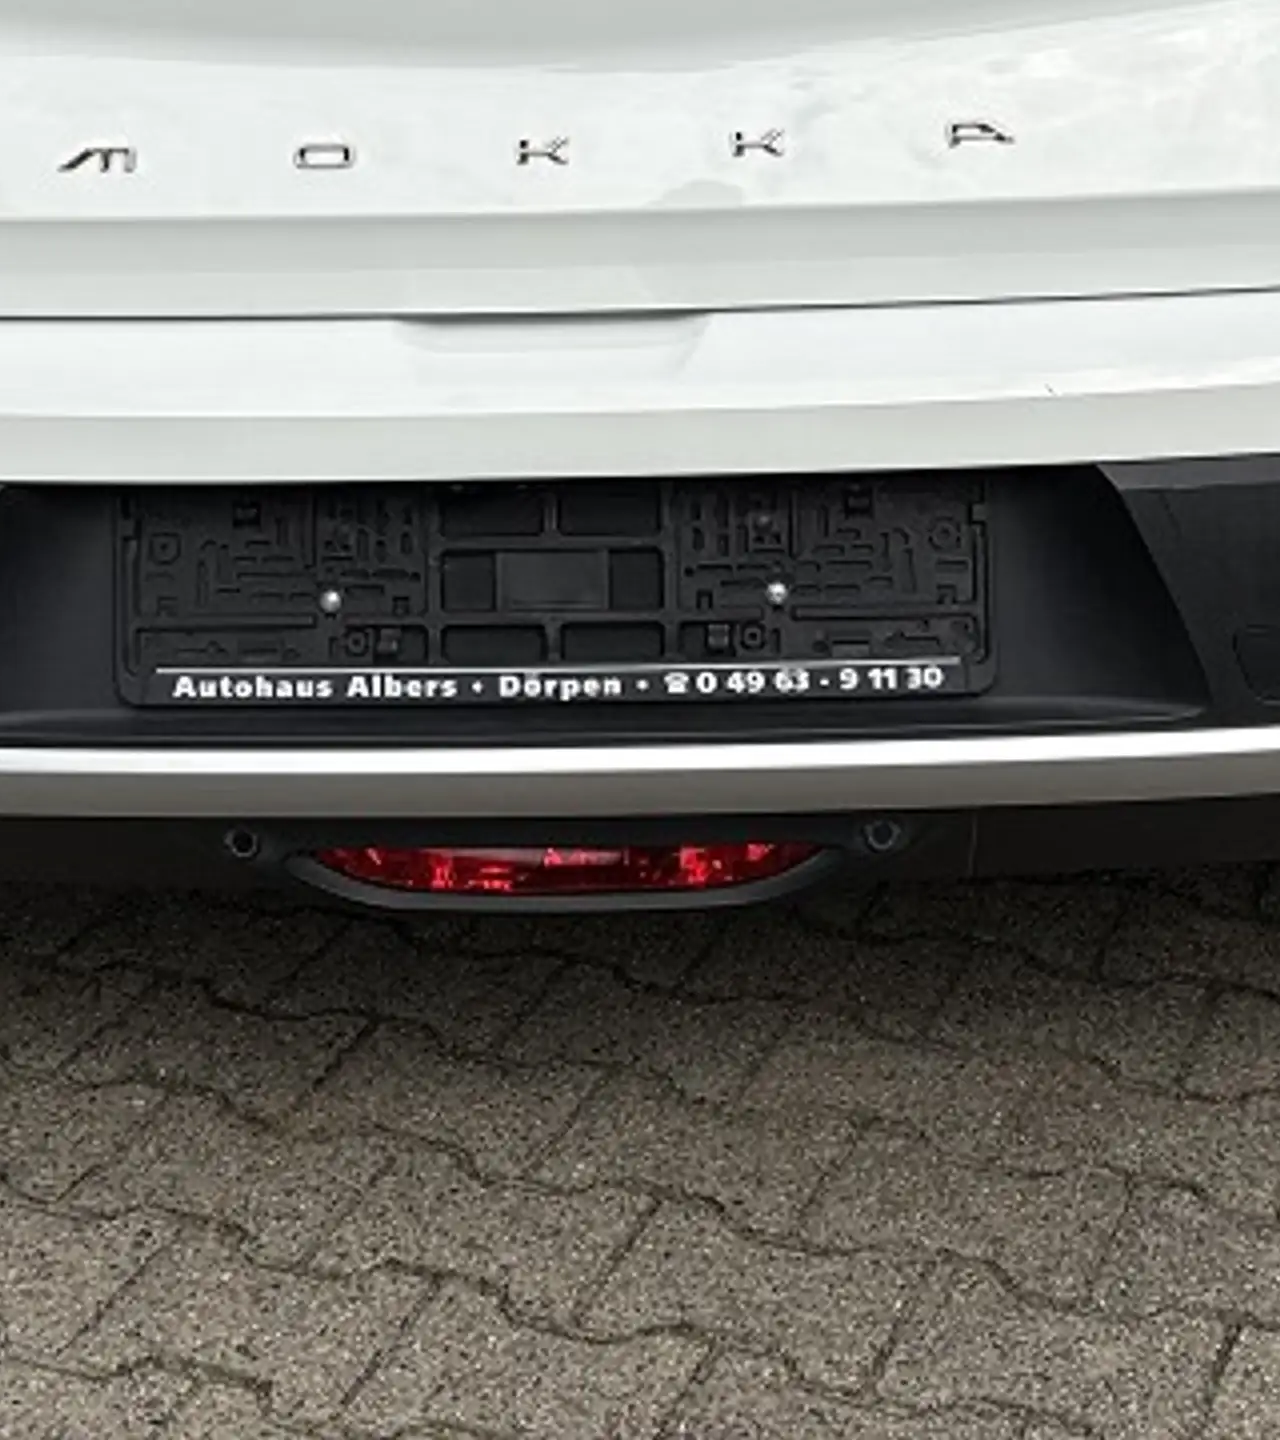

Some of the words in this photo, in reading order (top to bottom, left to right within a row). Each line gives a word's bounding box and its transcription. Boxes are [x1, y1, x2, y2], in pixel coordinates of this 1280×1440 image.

[56, 117, 1016, 174] MOKKA
[172, 674, 333, 698] Autohaus
[347, 673, 458, 698] Albers
[695, 670, 718, 694] 0
[725, 670, 766, 694] 49
[838, 667, 859, 691] 9
[867, 667, 898, 691] 11
